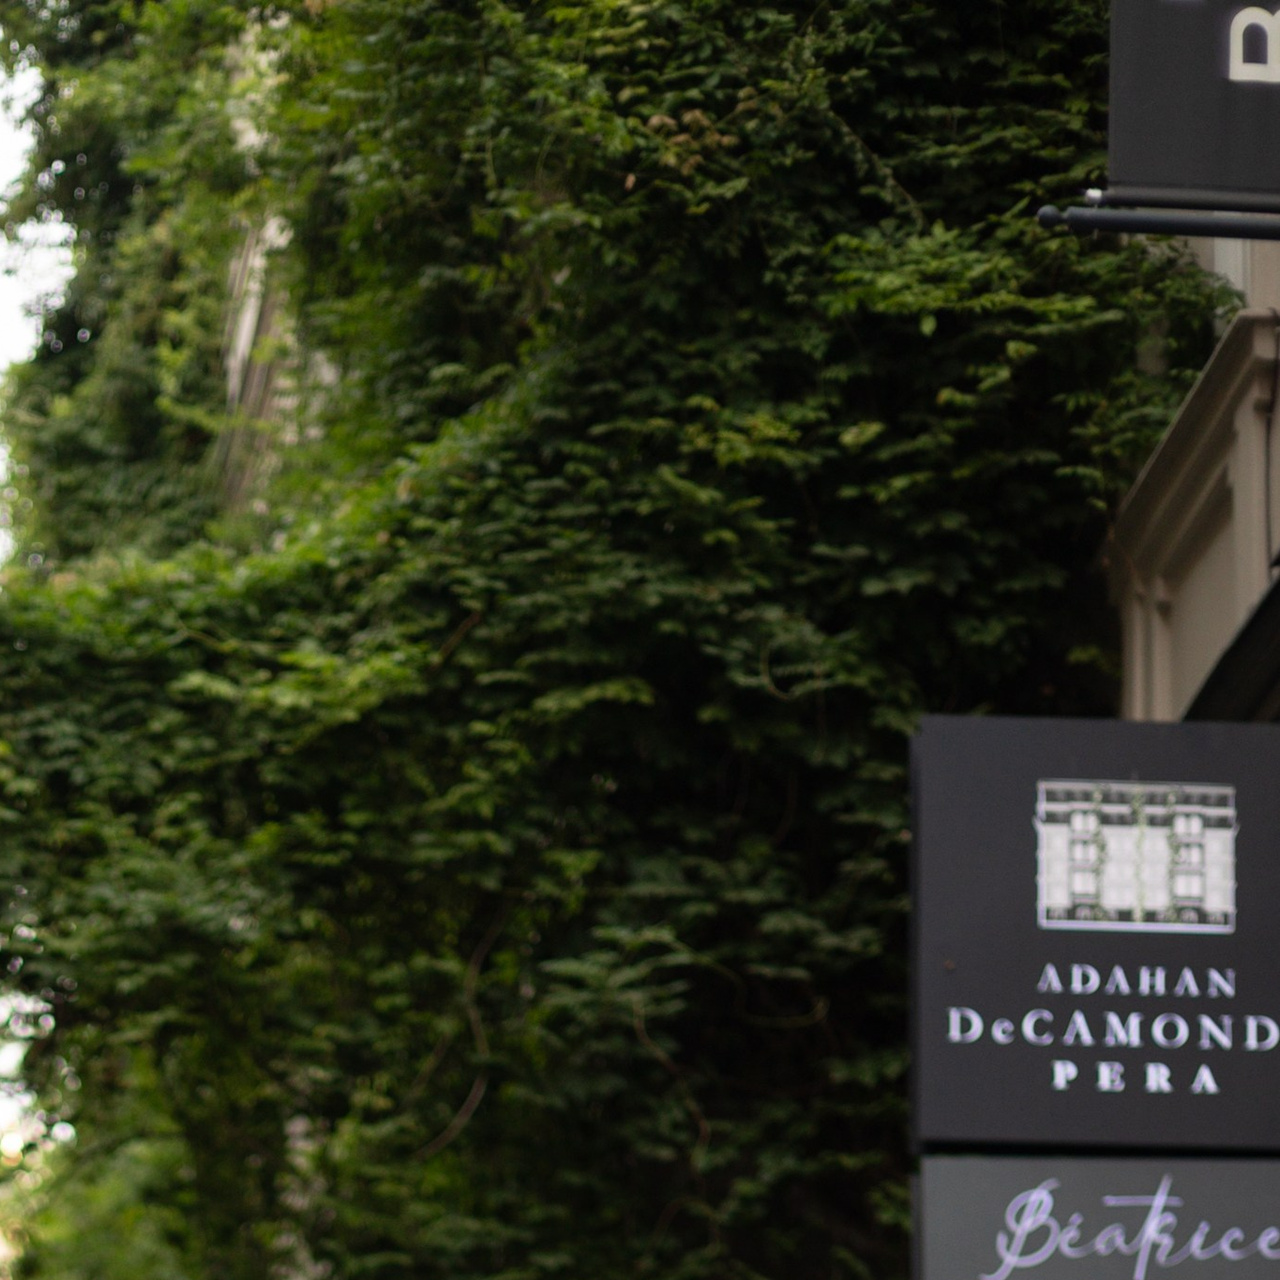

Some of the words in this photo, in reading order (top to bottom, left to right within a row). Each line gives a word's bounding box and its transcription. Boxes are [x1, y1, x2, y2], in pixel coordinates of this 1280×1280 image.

[1036, 961, 1236, 999] ADAHAN
[946, 1005, 1280, 1052] DeCAMOND
[1051, 1059, 1220, 1094] PERA
